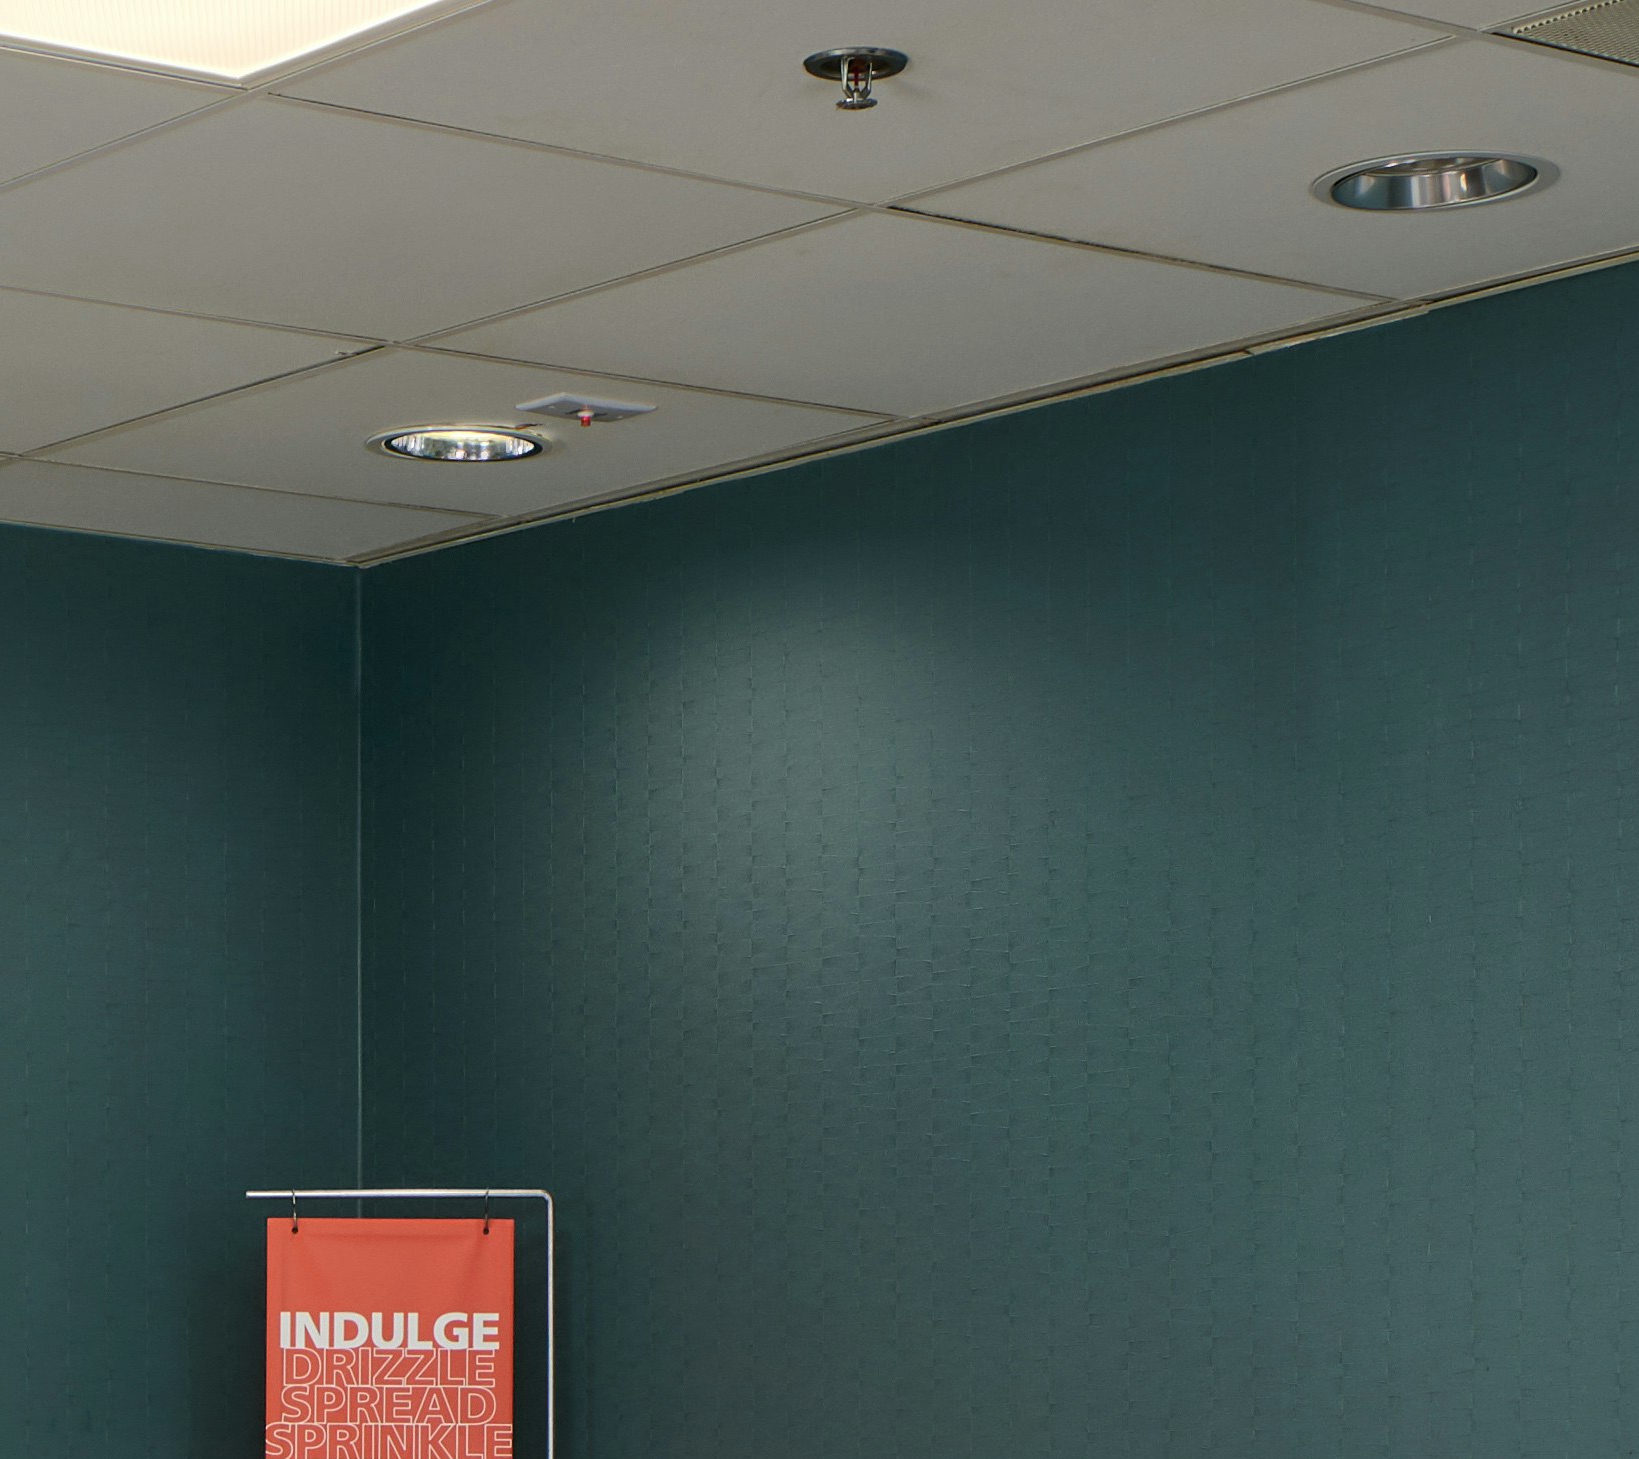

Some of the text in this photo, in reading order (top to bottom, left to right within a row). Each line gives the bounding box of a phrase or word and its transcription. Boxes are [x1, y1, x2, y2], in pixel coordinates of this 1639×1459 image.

[279, 1311, 500, 1350] INDULGE
[283, 1347, 496, 1387] DRIZZLE
[281, 1384, 497, 1425] SPREAD
